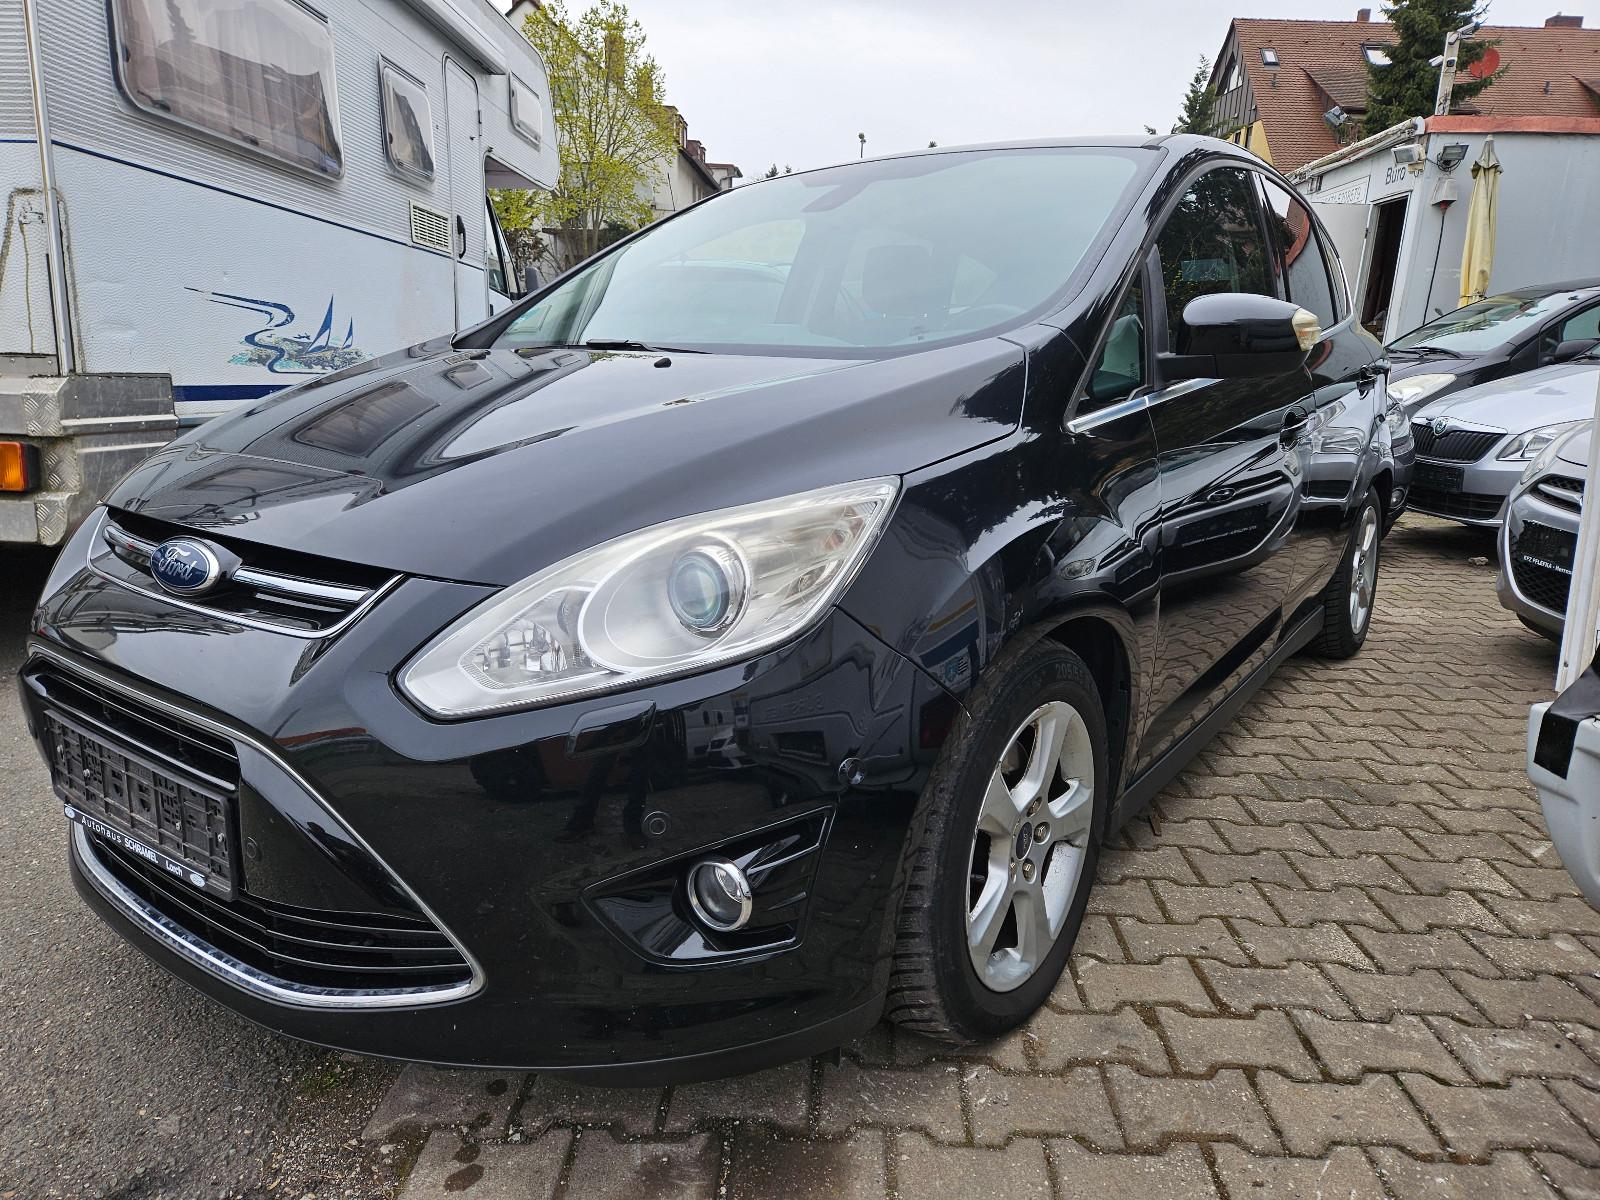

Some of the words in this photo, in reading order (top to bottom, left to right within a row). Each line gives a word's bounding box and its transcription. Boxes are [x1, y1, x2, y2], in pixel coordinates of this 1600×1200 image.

[158, 546, 198, 580] Ford
[81, 817, 122, 843] Autohaus
[124, 837, 159, 864] SCHRAMEL
